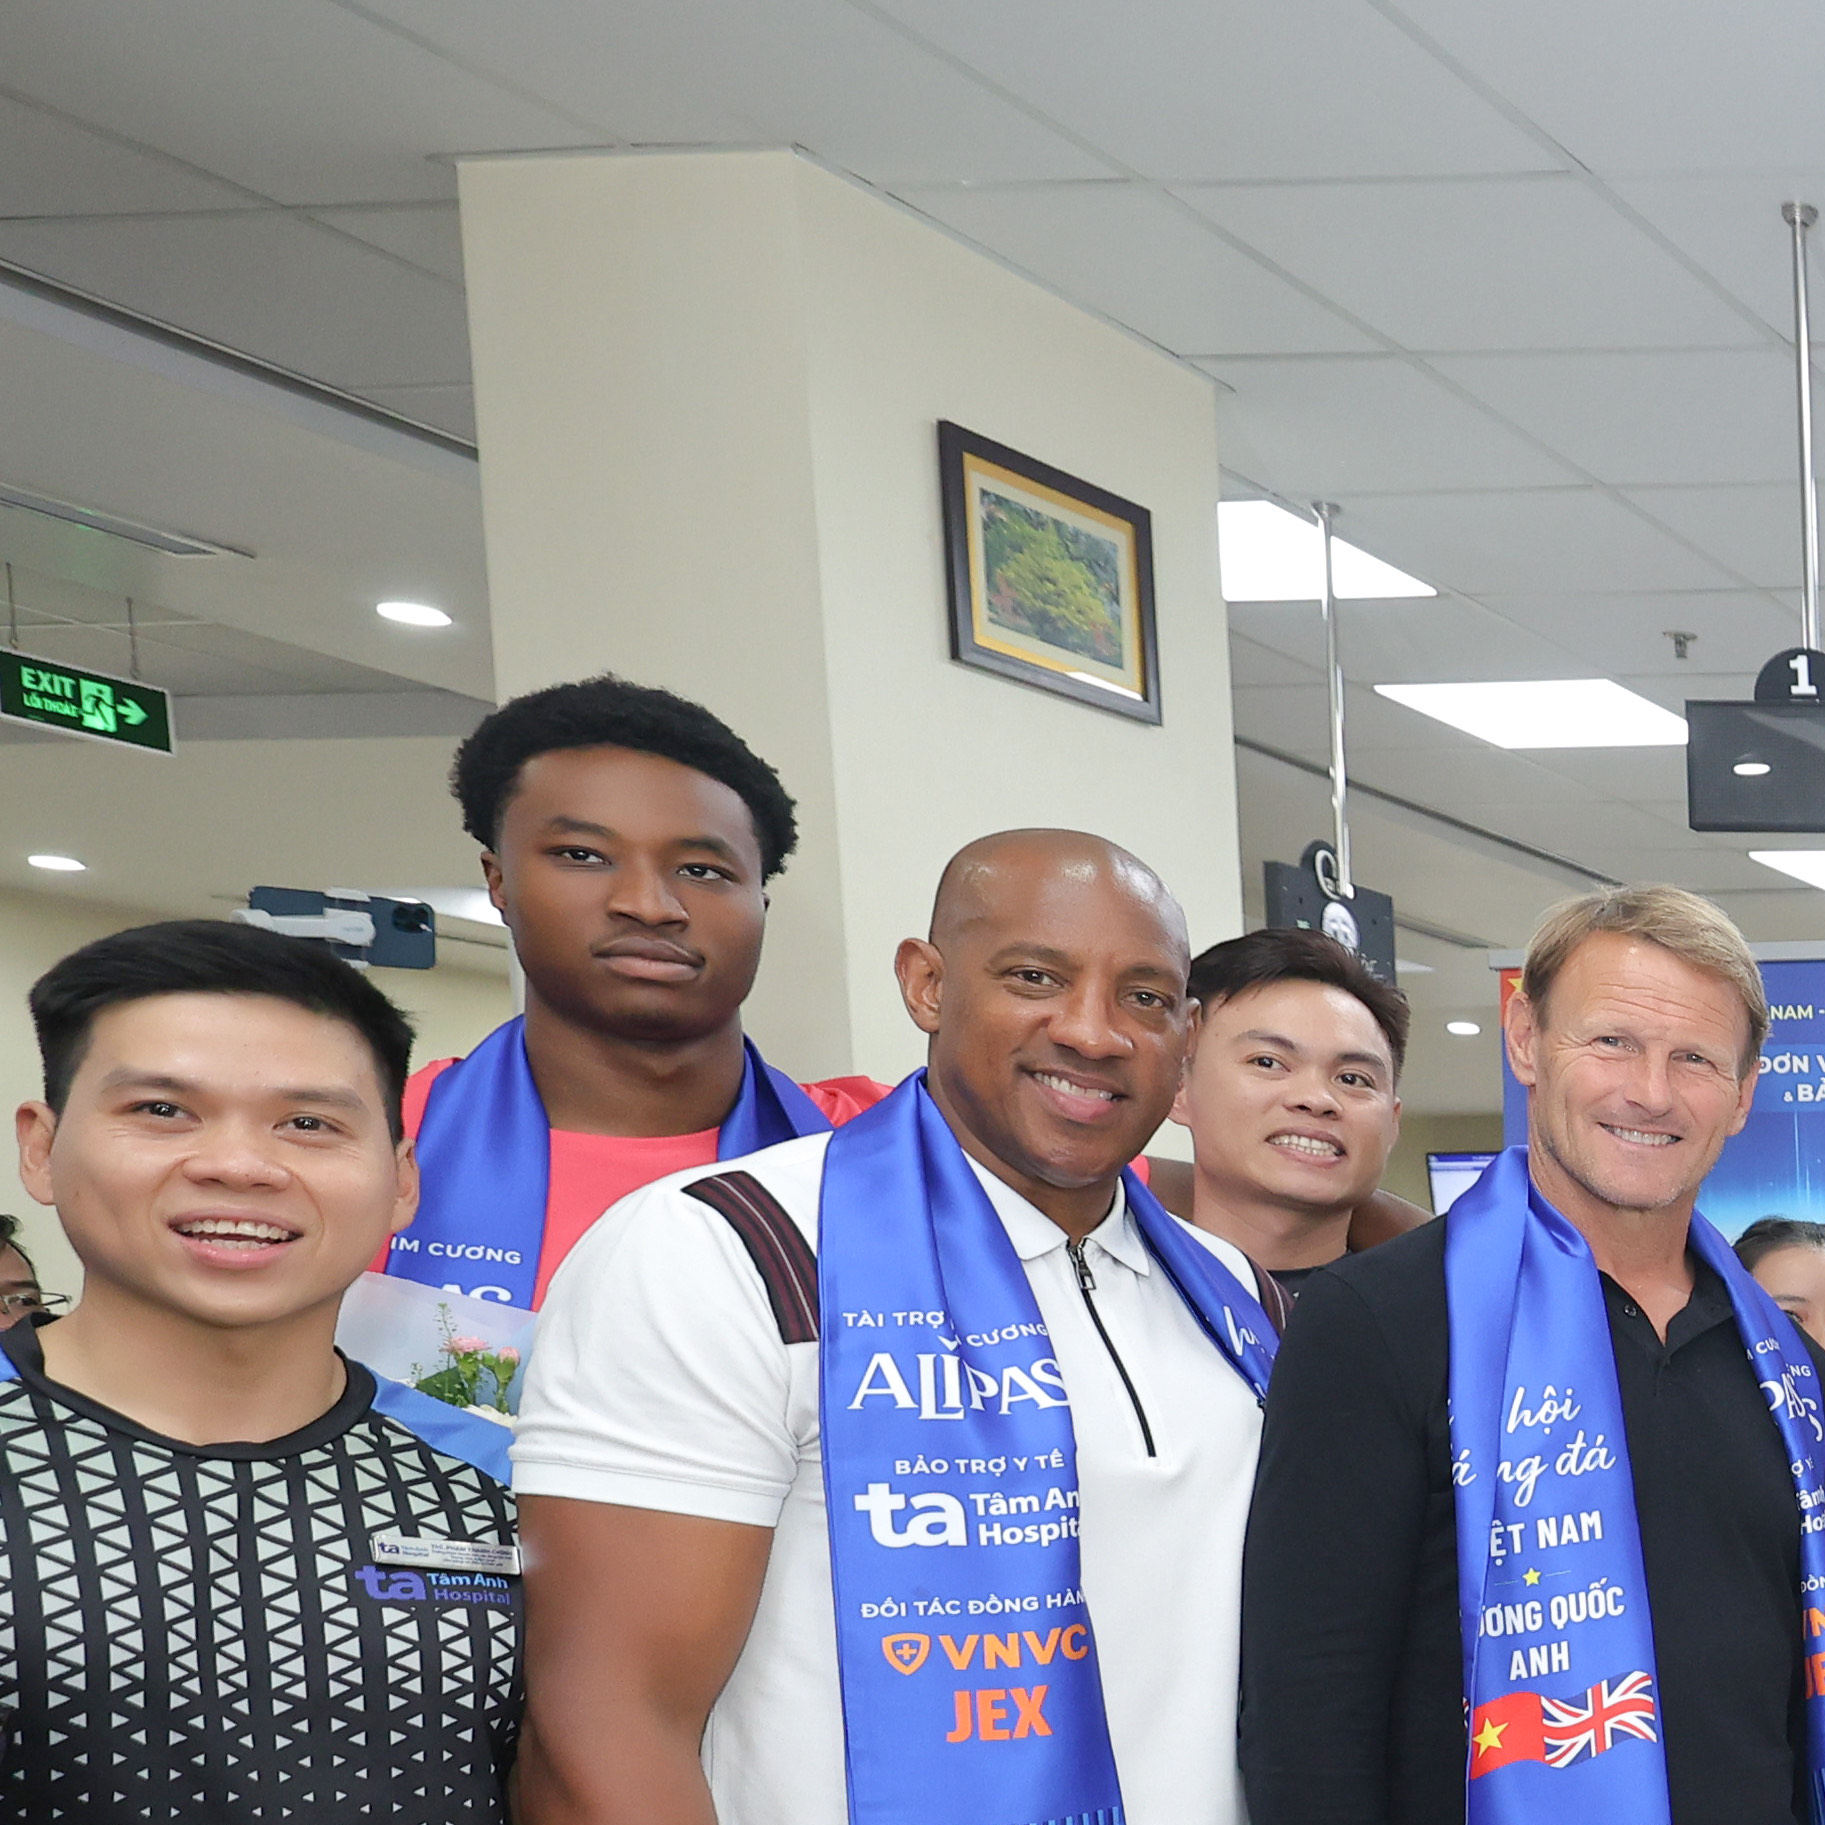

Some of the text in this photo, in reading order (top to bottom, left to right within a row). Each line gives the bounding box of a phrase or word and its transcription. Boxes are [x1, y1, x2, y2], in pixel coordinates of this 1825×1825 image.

[20, 665, 77, 699] EXIT
[1789, 655, 1817, 695] 1
[1770, 1004, 1814, 1021] NAM
[428, 1241, 522, 1265] CƯƠNG
[842, 1309, 945, 1329] TÀI TRỢ
[1506, 1384, 1581, 1435] hội
[894, 1455, 949, 1476] BẢO
[954, 1455, 1007, 1477] TRỢ
[1012, 1456, 1031, 1473] Y
[1555, 1429, 1616, 1476] đá
[854, 1481, 968, 1549] ta
[969, 1489, 1039, 1517] Tâm
[1536, 1510, 1603, 1550] NAM
[378, 1541, 400, 1555] ta
[354, 1565, 509, 1601] ta Tâm Anh
[433, 1588, 511, 1606] Hospital
[860, 1596, 906, 1618] ĐỐI
[912, 1595, 961, 1617] TÁC
[967, 1590, 1040, 1616] ĐỒNG
[1550, 1577, 1625, 1630] QUỐC
[938, 1624, 1088, 1671] VNVC
[1509, 1640, 1570, 1681] ANH
[946, 1685, 1052, 1743] JEX
